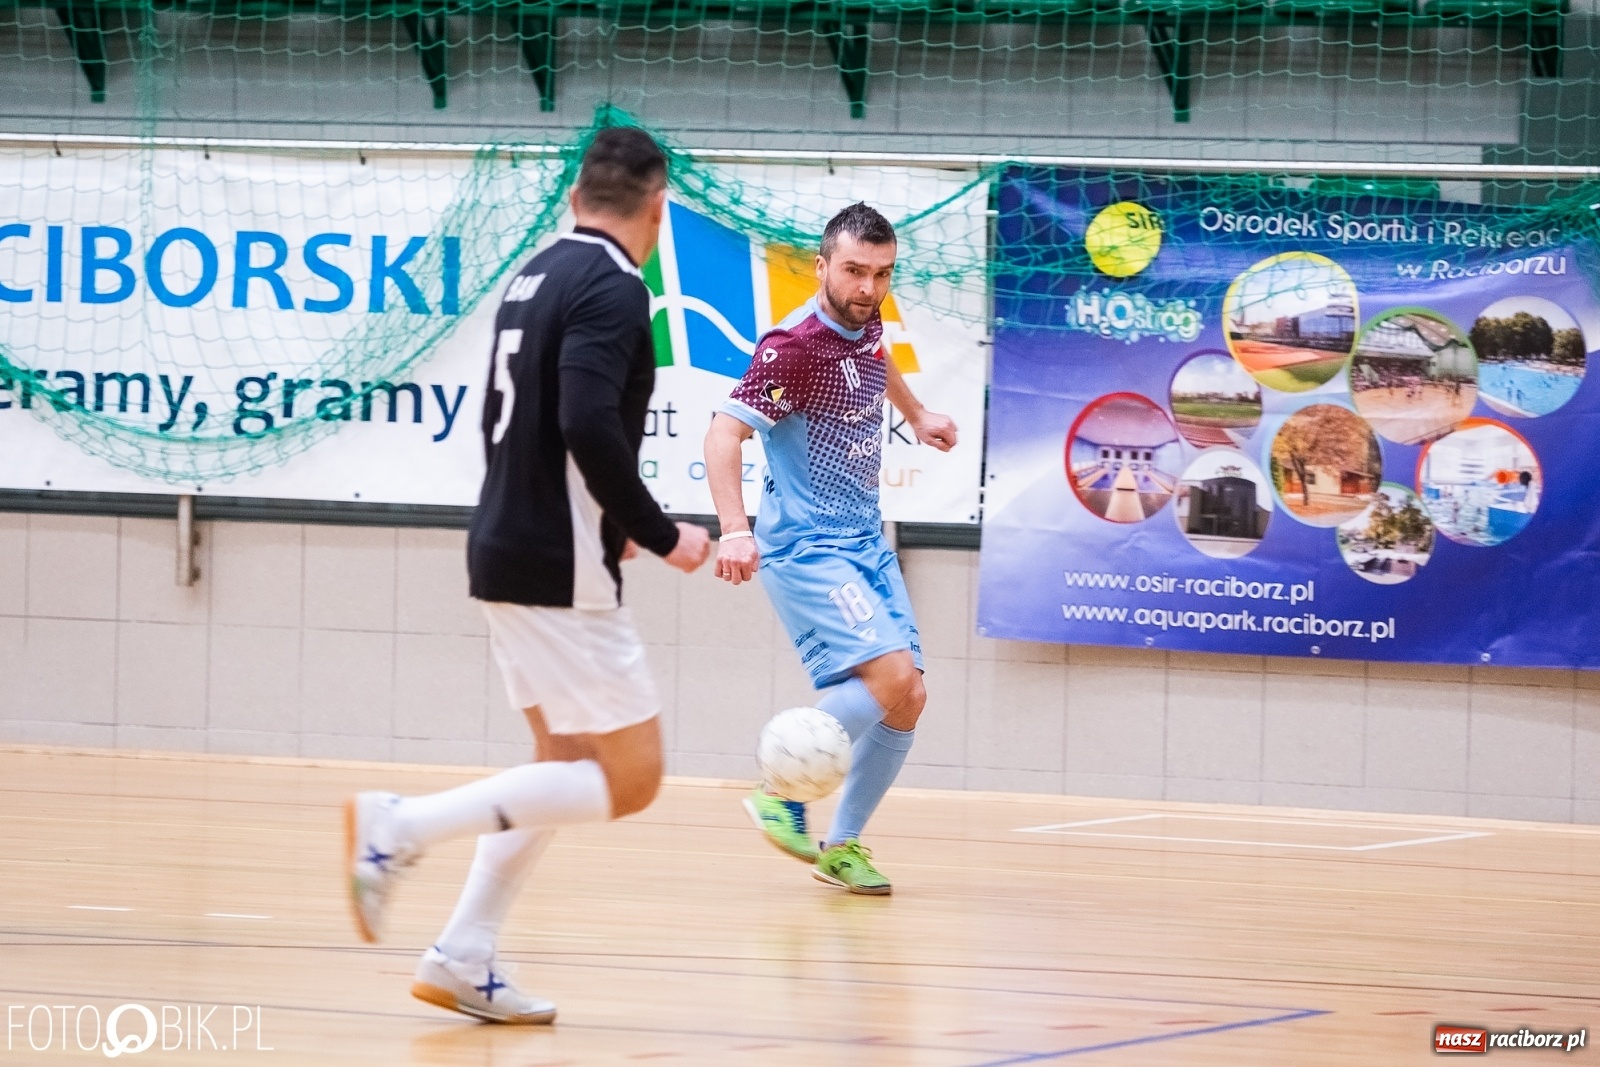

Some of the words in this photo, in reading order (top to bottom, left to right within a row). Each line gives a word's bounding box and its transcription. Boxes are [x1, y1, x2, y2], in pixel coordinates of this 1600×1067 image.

[1327, 214, 1418, 245] Sportu
[1427, 221, 1434, 244] i
[492, 328, 524, 445] 5
[840, 357, 861, 392] 18
[232, 371, 468, 443] gramy
[828, 581, 875, 630] 18
[1064, 570, 1315, 605] www.osir-raciborz.pl
[1061, 603, 1396, 643] www.aquapark.raciborz.pl
